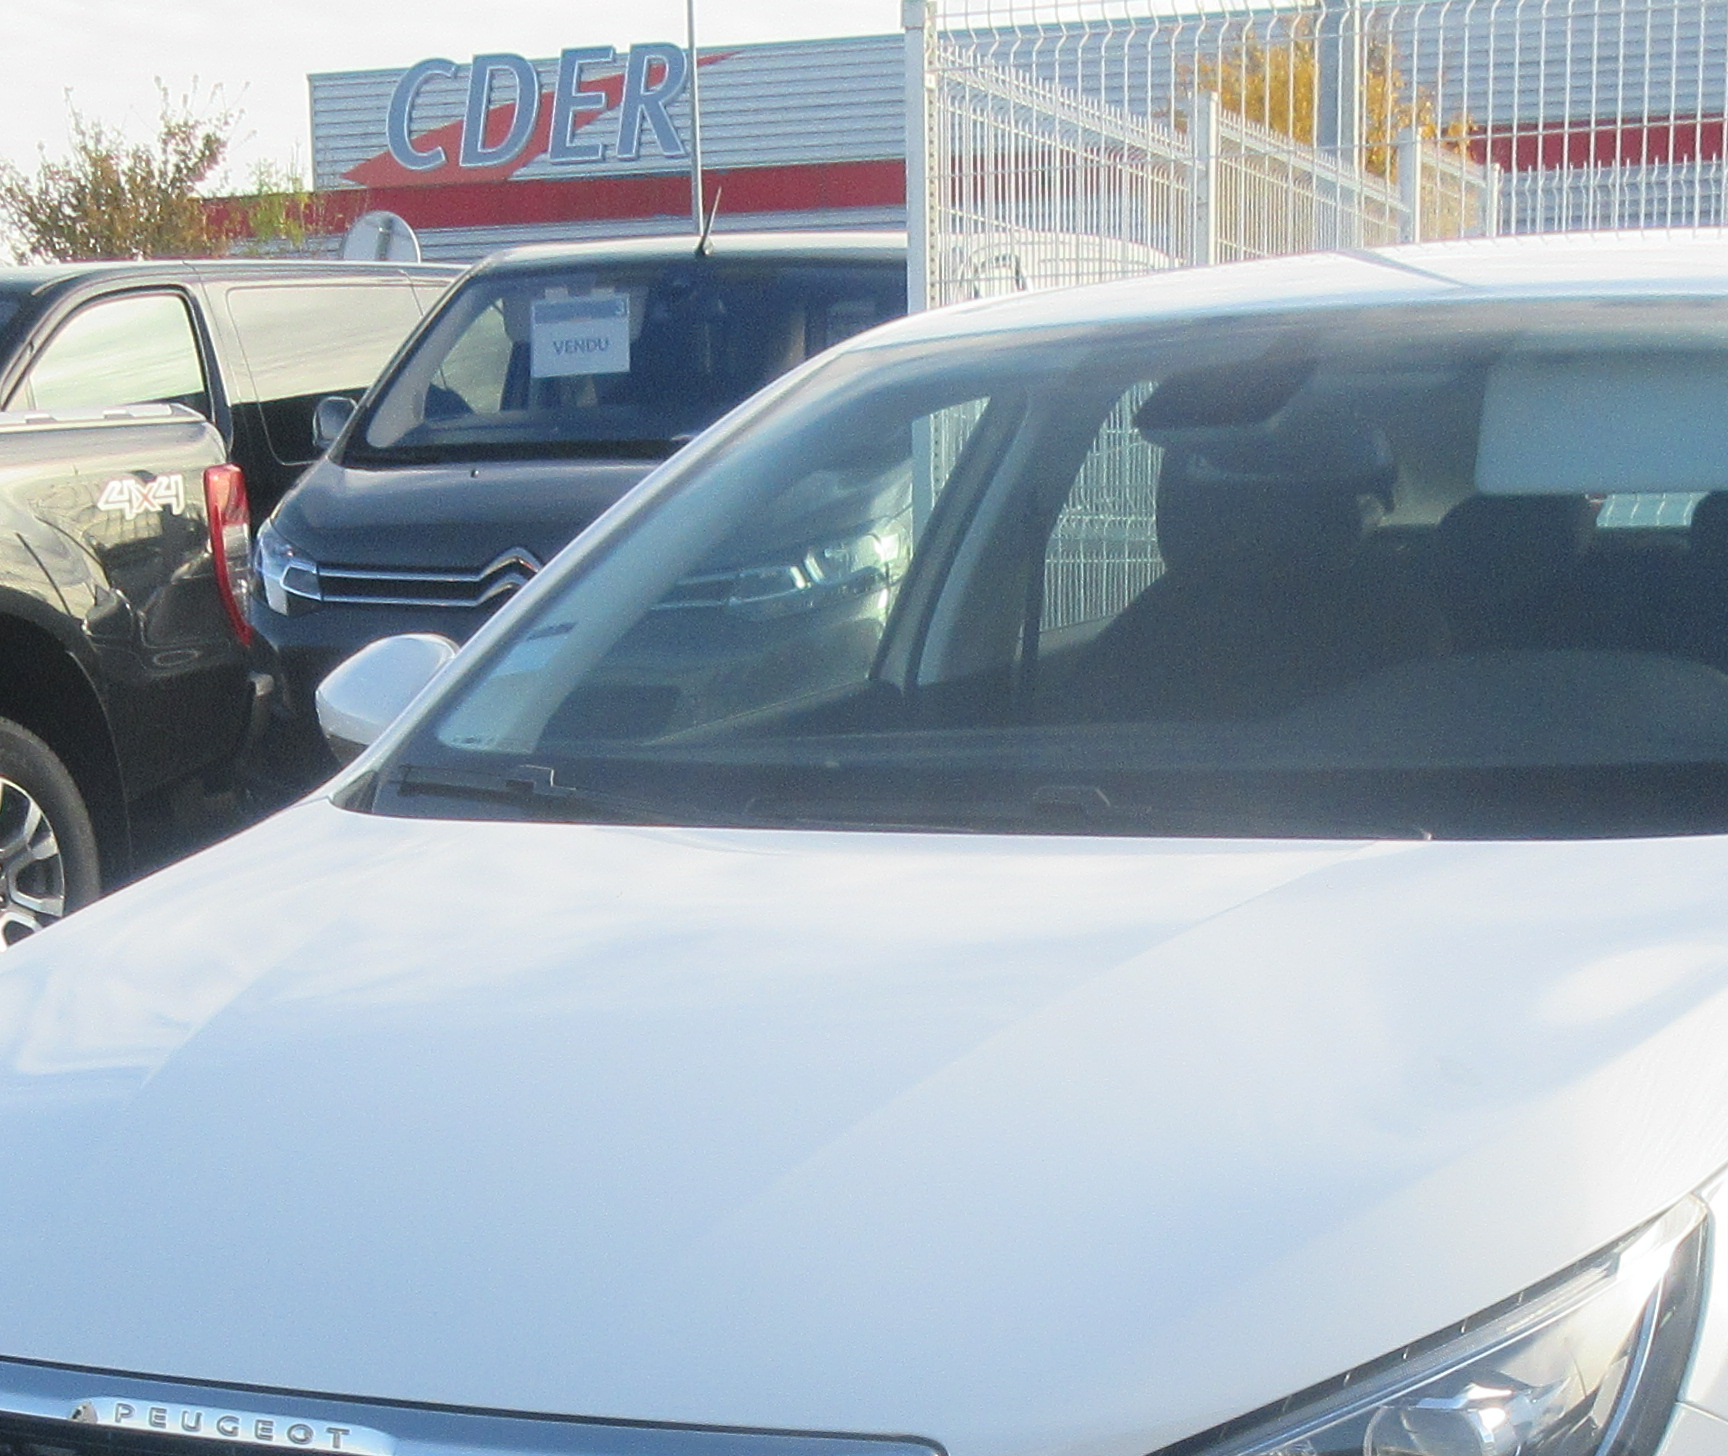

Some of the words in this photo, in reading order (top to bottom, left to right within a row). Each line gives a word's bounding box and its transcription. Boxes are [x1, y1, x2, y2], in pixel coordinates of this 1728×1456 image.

[385, 42, 690, 172] CDER
[553, 337, 611, 355] VENDU
[114, 1401, 351, 1449] PEUGEOT
